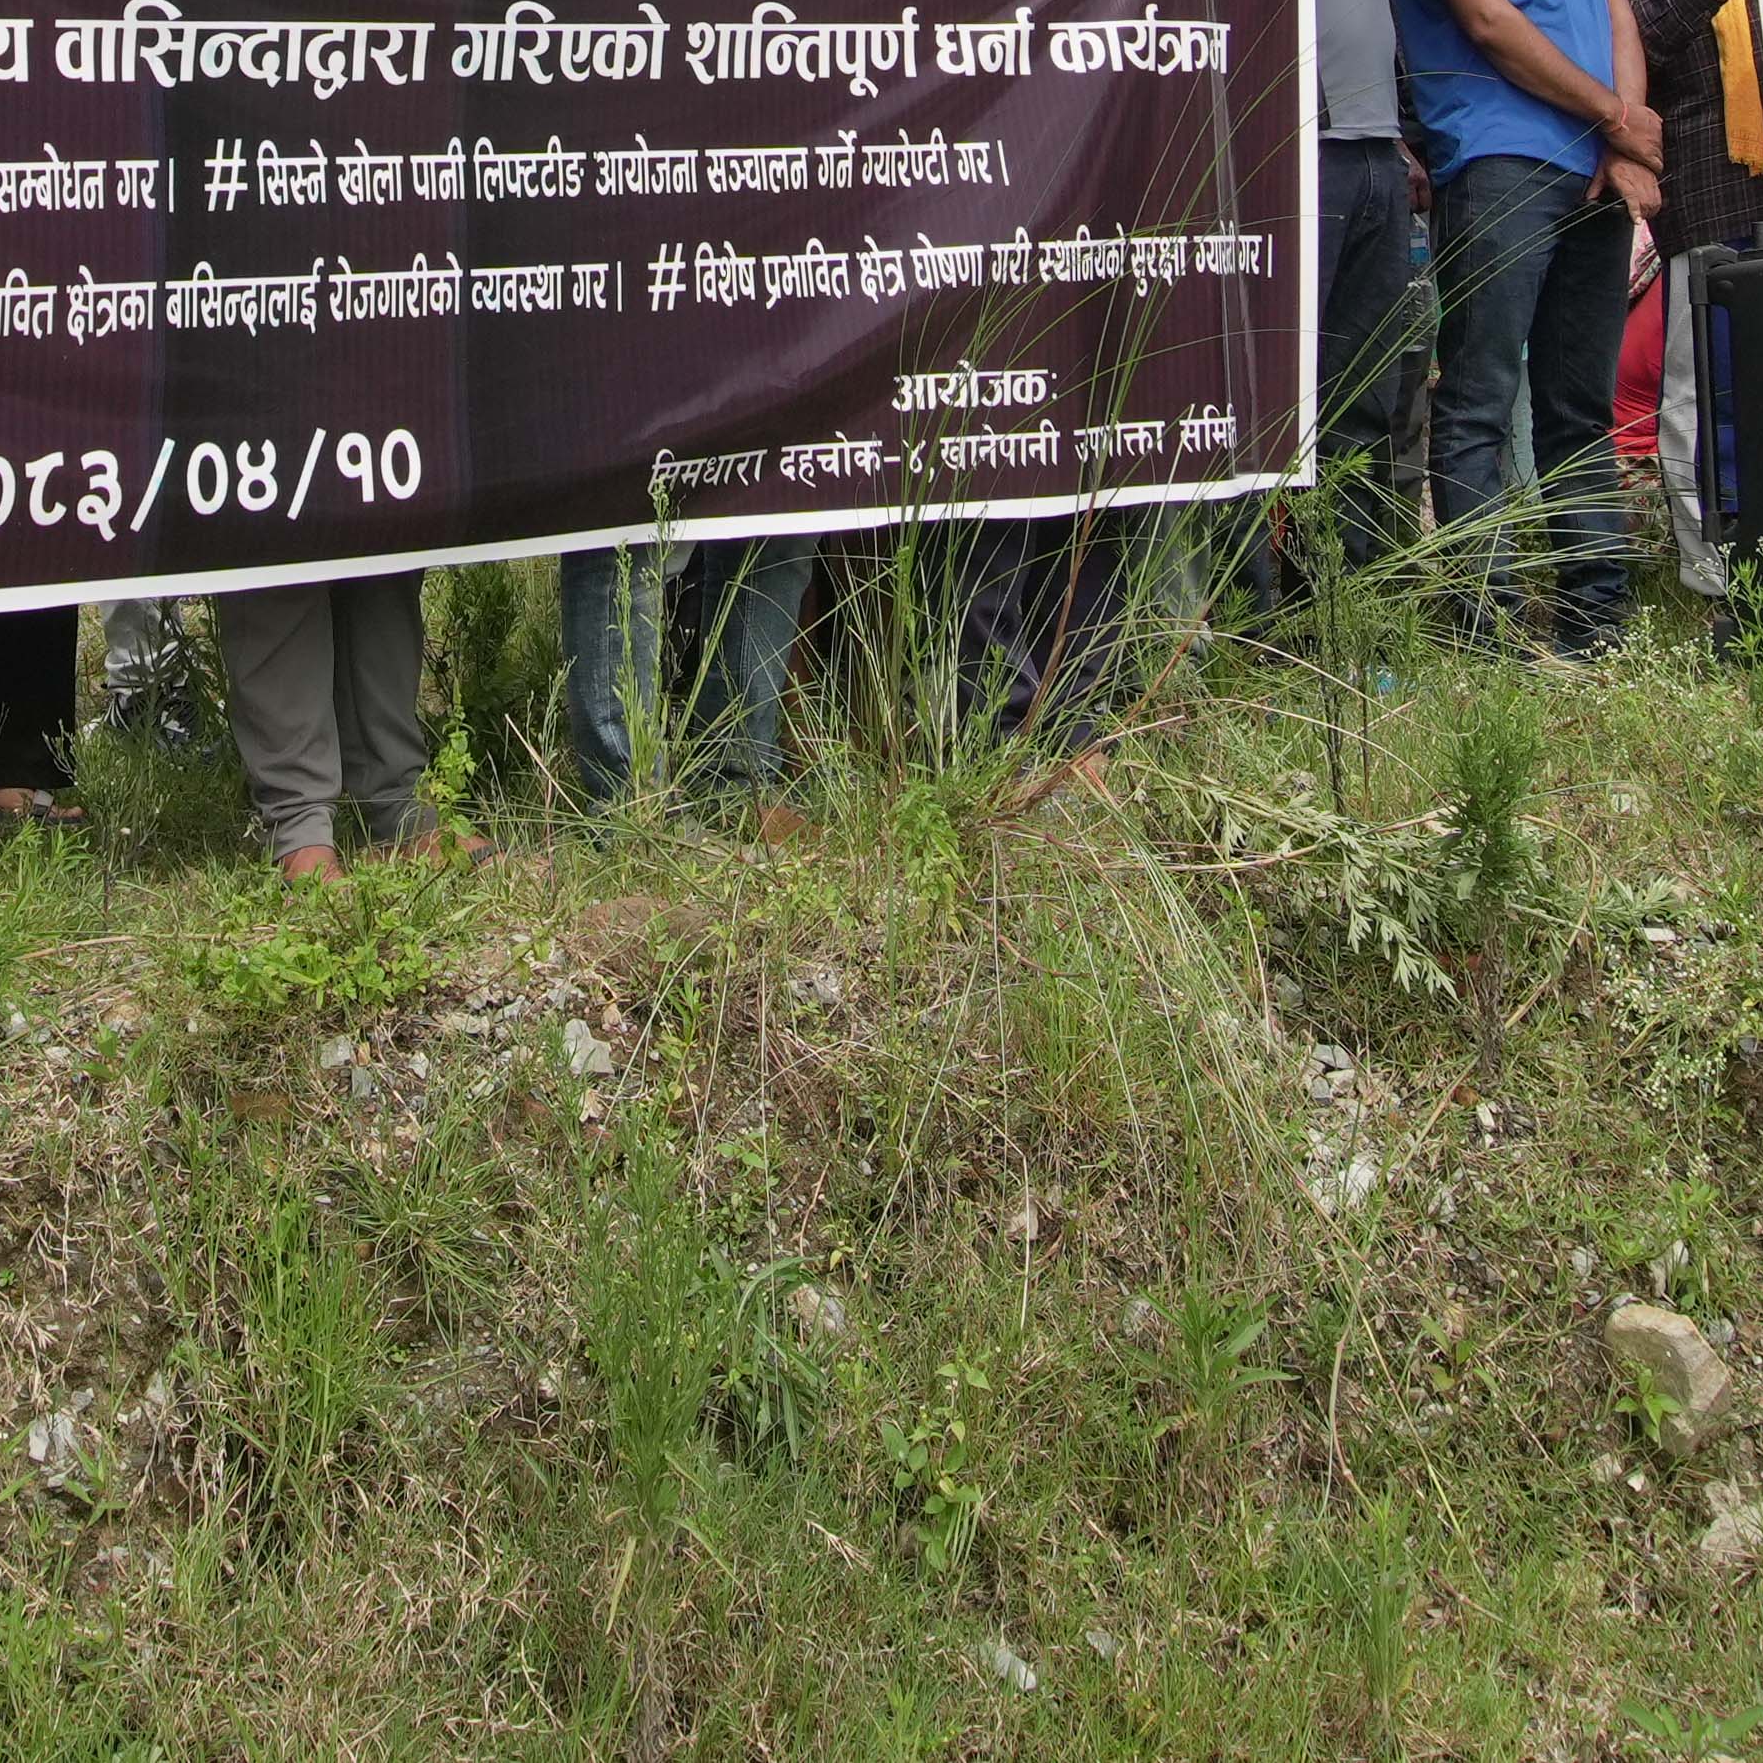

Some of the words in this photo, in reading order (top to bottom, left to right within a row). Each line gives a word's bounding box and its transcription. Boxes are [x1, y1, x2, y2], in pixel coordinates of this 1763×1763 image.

[452, 1, 670, 84] गरिएको
[685, 2, 919, 98] शान्तिपूर्ण
[935, 7, 1034, 76] धर्ना
[1048, 4, 1230, 75] कार्यक्रम
[257, 139, 327, 205] सिस्ने
[336, 138, 403, 205] खोला
[410, 137, 466, 200] पानी
[594, 134, 698, 195] आयोजना
[705, 147, 808, 193] सञ्चालन
[815, 130, 857, 188] गर्ने
[862, 128, 949, 187] ग्यारेण्टी
[67, 265, 157, 345] क्षेत्रका
[165, 257, 324, 336] बासिन्दालाई
[329, 252, 463, 321] रोजगारीको
[471, 265, 564, 312] व्यवस्था
[695, 241, 756, 306] विशेष
[762, 238, 850, 309] प्रभावित
[856, 235, 906, 303] क्षेत्र
[910, 232, 984, 289] घोषणा
